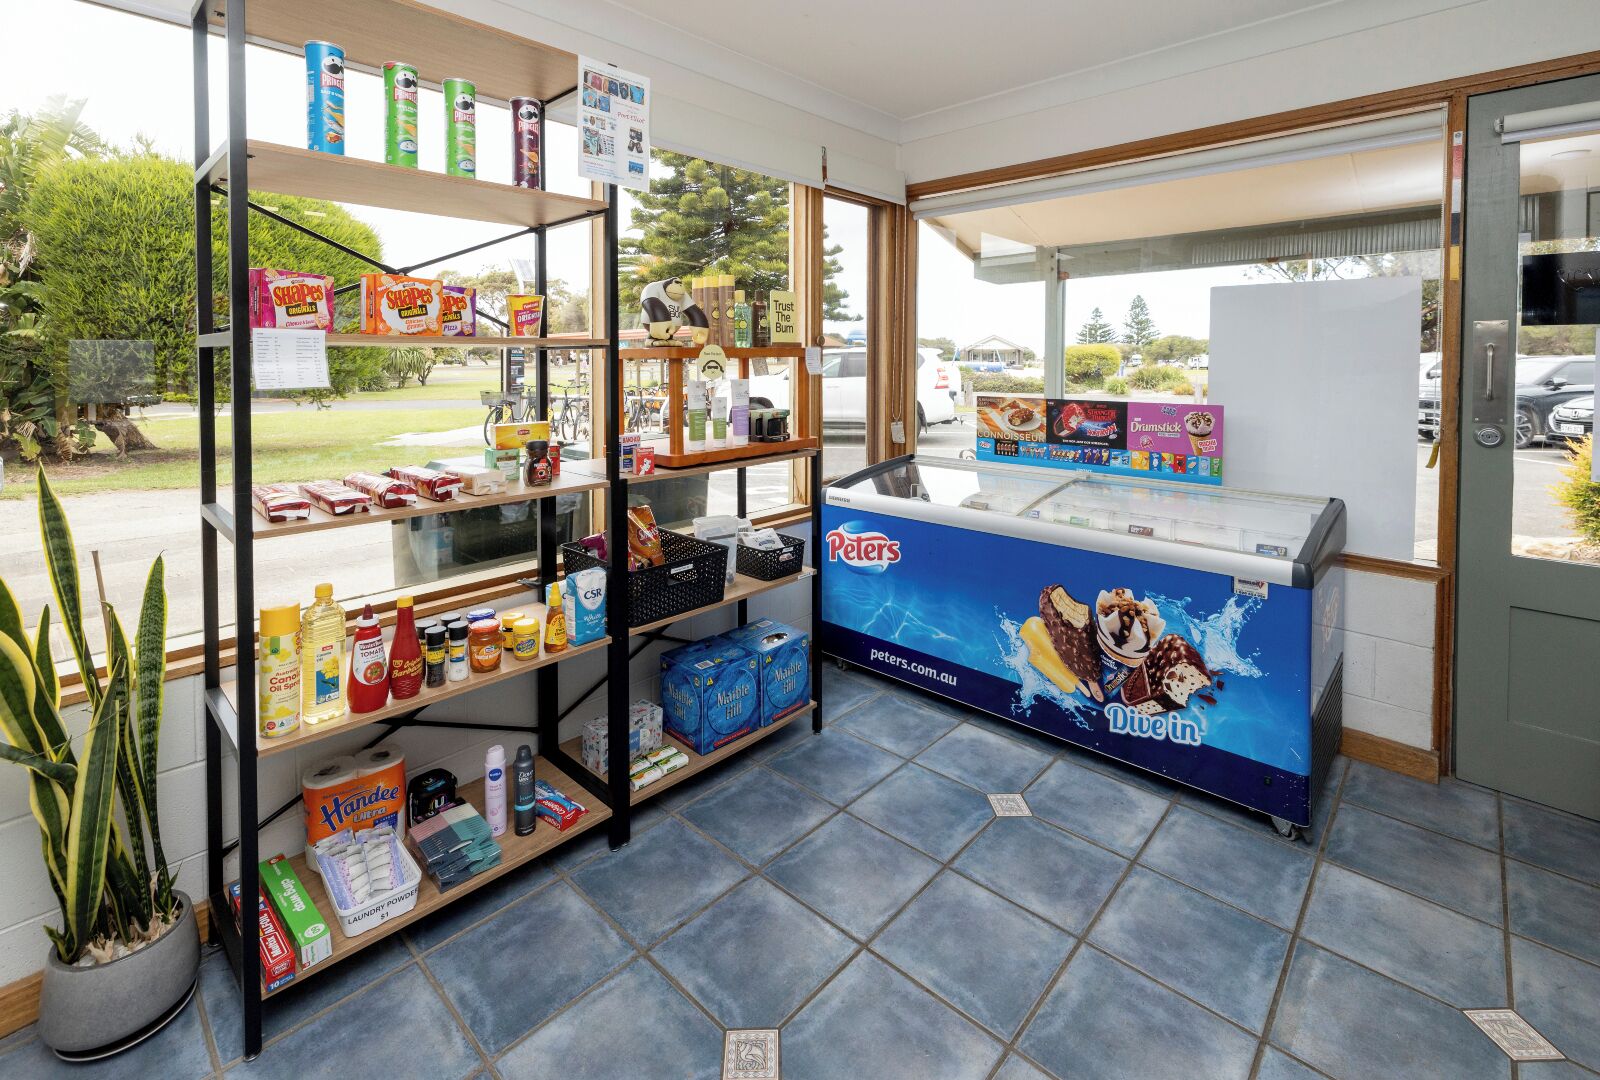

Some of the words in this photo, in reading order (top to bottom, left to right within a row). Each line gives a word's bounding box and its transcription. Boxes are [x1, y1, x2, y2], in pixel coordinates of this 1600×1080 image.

[288, 305, 317, 315] ORIGINALS
[773, 300, 795, 312] Trust
[775, 311, 791, 323] The
[775, 322, 794, 334] Bum
[1130, 421, 1182, 433] Drumstick
[977, 431, 1045, 442] CONNOISSEUR
[826, 530, 901, 562] Peters
[584, 587, 603, 600] CSR
[774, 661, 802, 682] Marble
[870, 648, 958, 686] peters.com.au
[269, 685, 282, 693] Oil
[783, 678, 796, 695] Hill
[717, 683, 750, 709] Marble
[725, 701, 742, 720] Hill
[1105, 704, 1165, 738] Dive
[1169, 711, 1200, 744] in
[320, 785, 401, 832] Handee
[353, 806, 387, 823] Ultra
[290, 892, 306, 912] wrap
[347, 902, 386, 925] LAUNDRY
[380, 911, 390, 921] $1
[269, 982, 280, 991] 10
